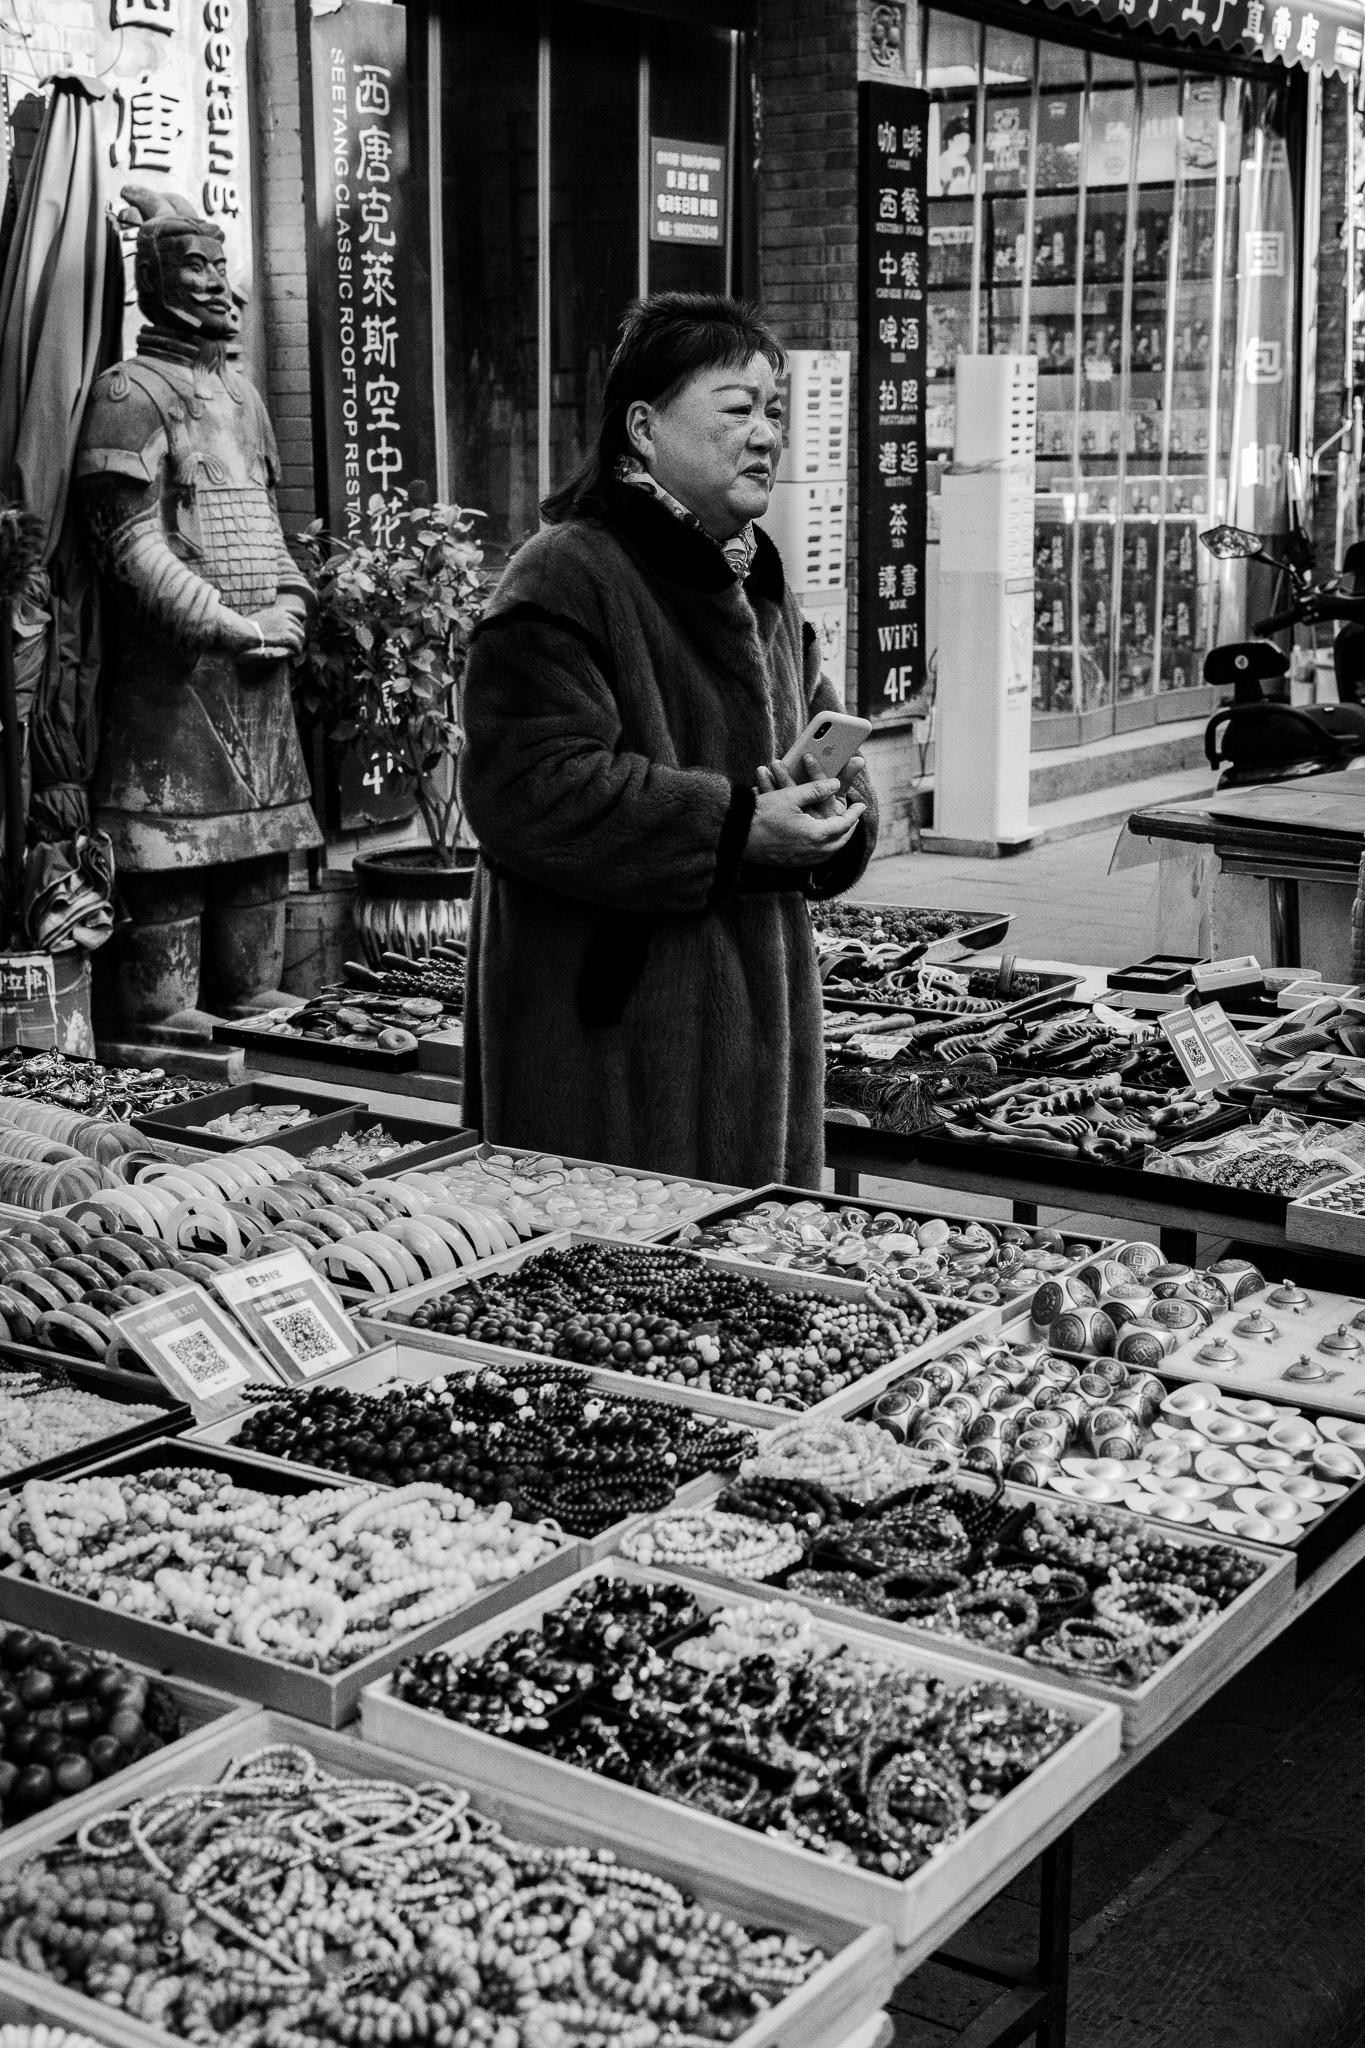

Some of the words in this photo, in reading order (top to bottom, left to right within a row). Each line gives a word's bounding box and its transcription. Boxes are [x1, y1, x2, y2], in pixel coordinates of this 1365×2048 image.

[330, 48, 350, 176] SEETANG
[879, 187, 920, 223] 西餐
[335, 184, 353, 299] CLASSIC
[878, 250, 920, 287] 中餐
[879, 315, 920, 350] 啤酒
[339, 306, 358, 437] ROOFTOP
[878, 379, 919, 412] 拍照
[889, 502, 908, 536] 茶
[877, 622, 918, 652] WiFi
[883, 665, 913, 703] 4F
